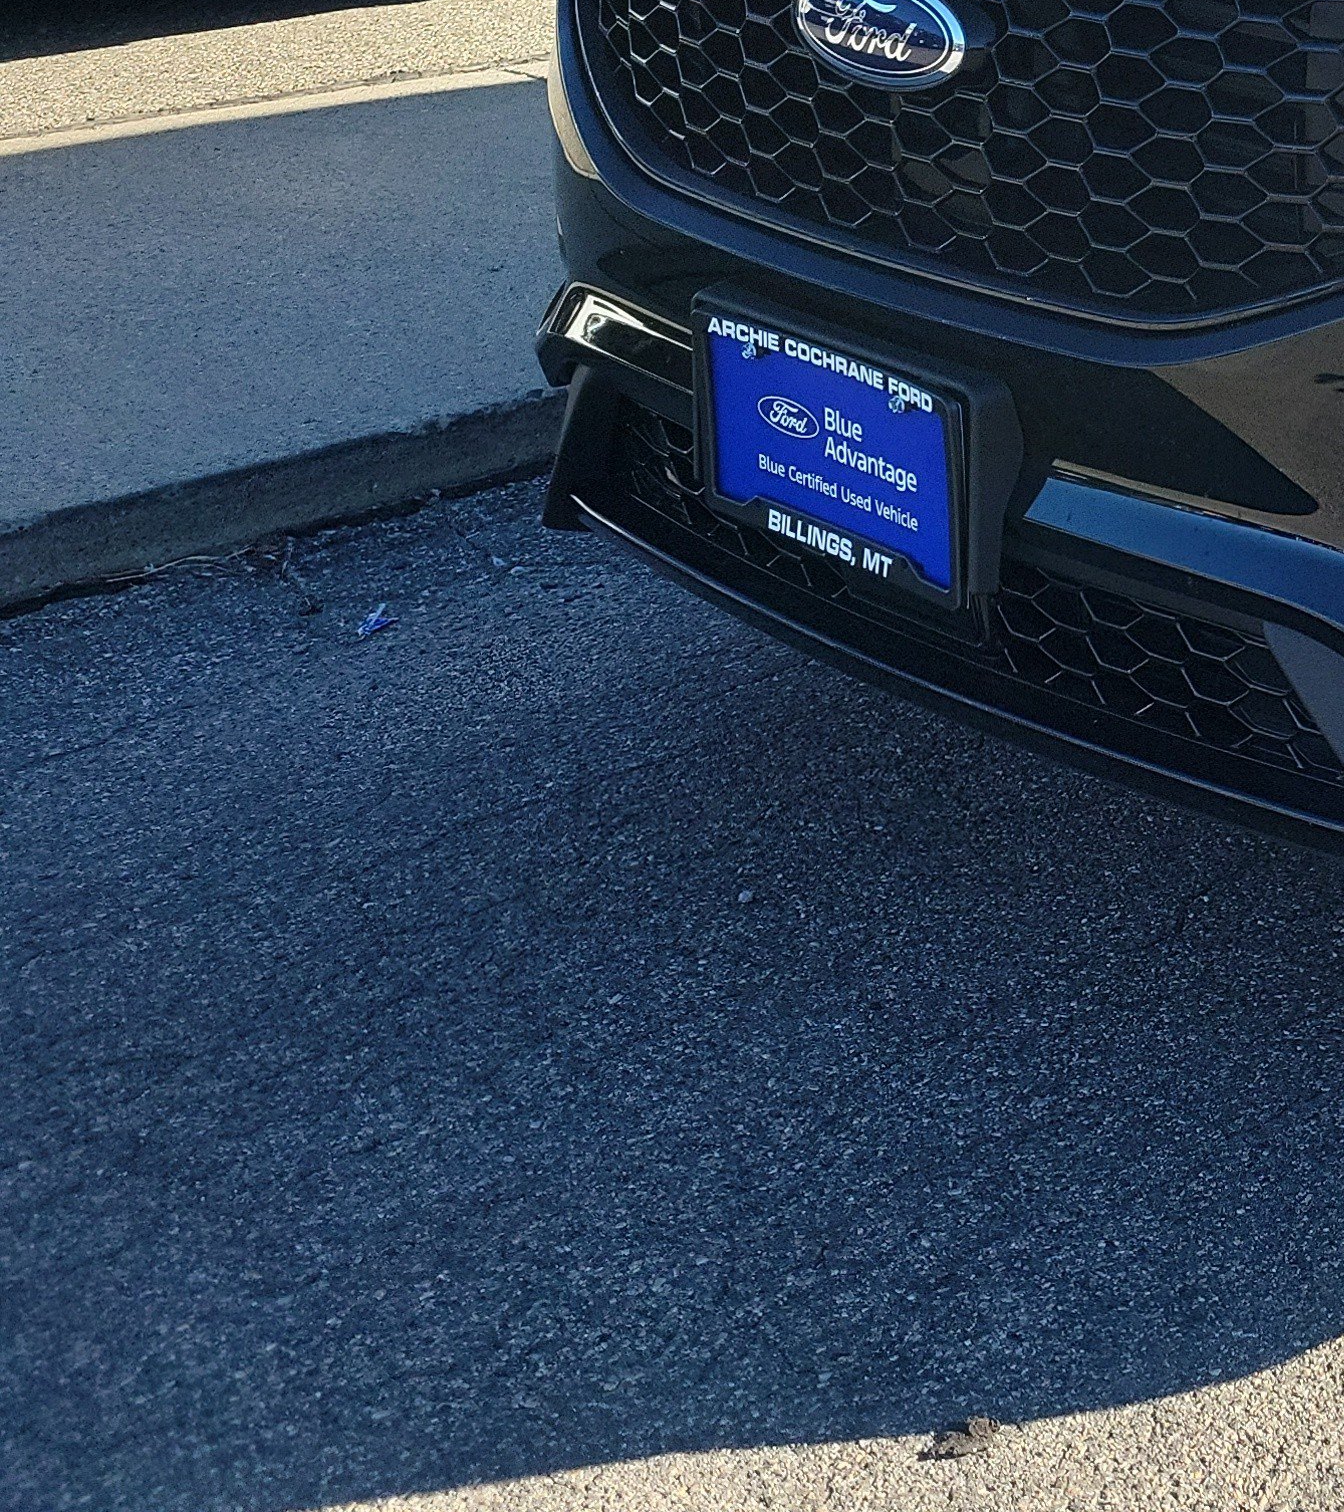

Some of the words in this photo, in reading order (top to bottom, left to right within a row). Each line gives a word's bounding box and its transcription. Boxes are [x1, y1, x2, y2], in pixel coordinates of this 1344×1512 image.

[708, 317, 780, 352] ARCHIE
[784, 338, 884, 390] COCHRANE
[888, 376, 933, 413] FORD
[769, 400, 808, 434] Ford
[824, 407, 863, 442] Blue
[758, 453, 786, 477] Blue
[788, 465, 838, 499] Certified
[840, 485, 872, 512] Used
[875, 499, 919, 531] Vehicle
[824, 436, 918, 493] Advantage
[768, 508, 856, 567] BILLINGS,
[862, 548, 893, 578] MT
